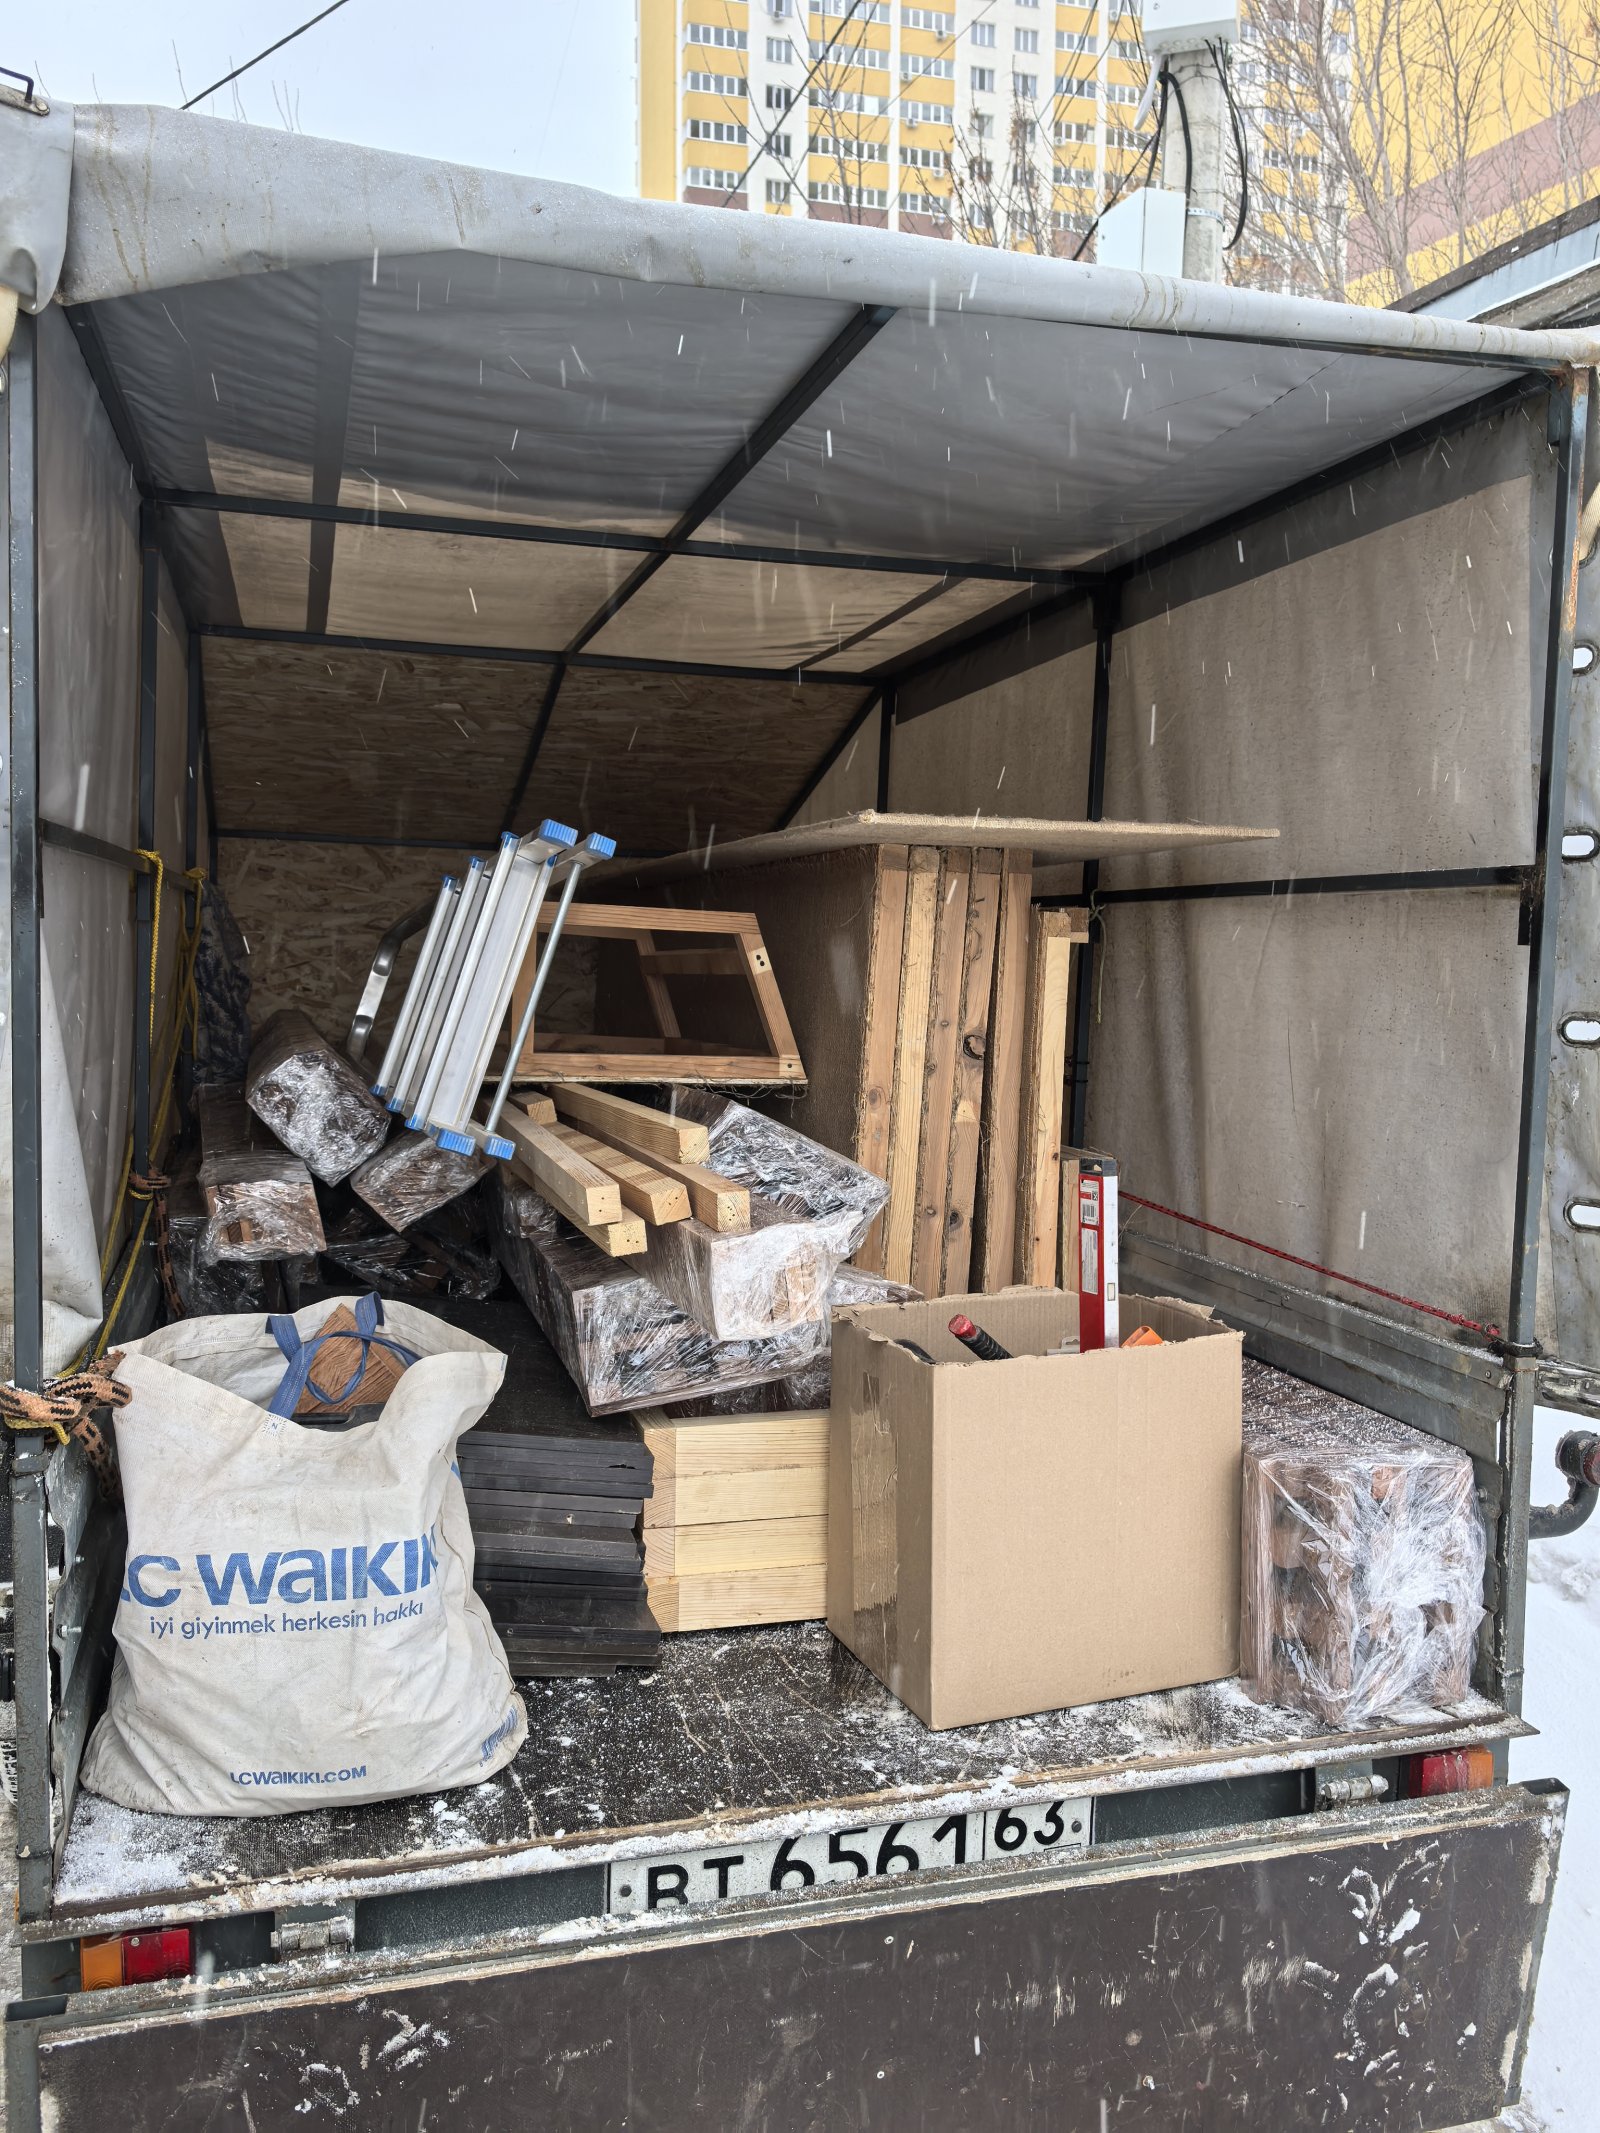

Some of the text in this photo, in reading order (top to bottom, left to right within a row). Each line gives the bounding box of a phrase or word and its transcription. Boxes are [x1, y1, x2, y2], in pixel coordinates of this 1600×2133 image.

[120, 1554, 182, 1607] C
[150, 1616, 174, 1639] iyi
[181, 1614, 276, 1640] giyinmek
[282, 1610, 367, 1632] herkesin
[994, 1801, 1065, 1851] 63
